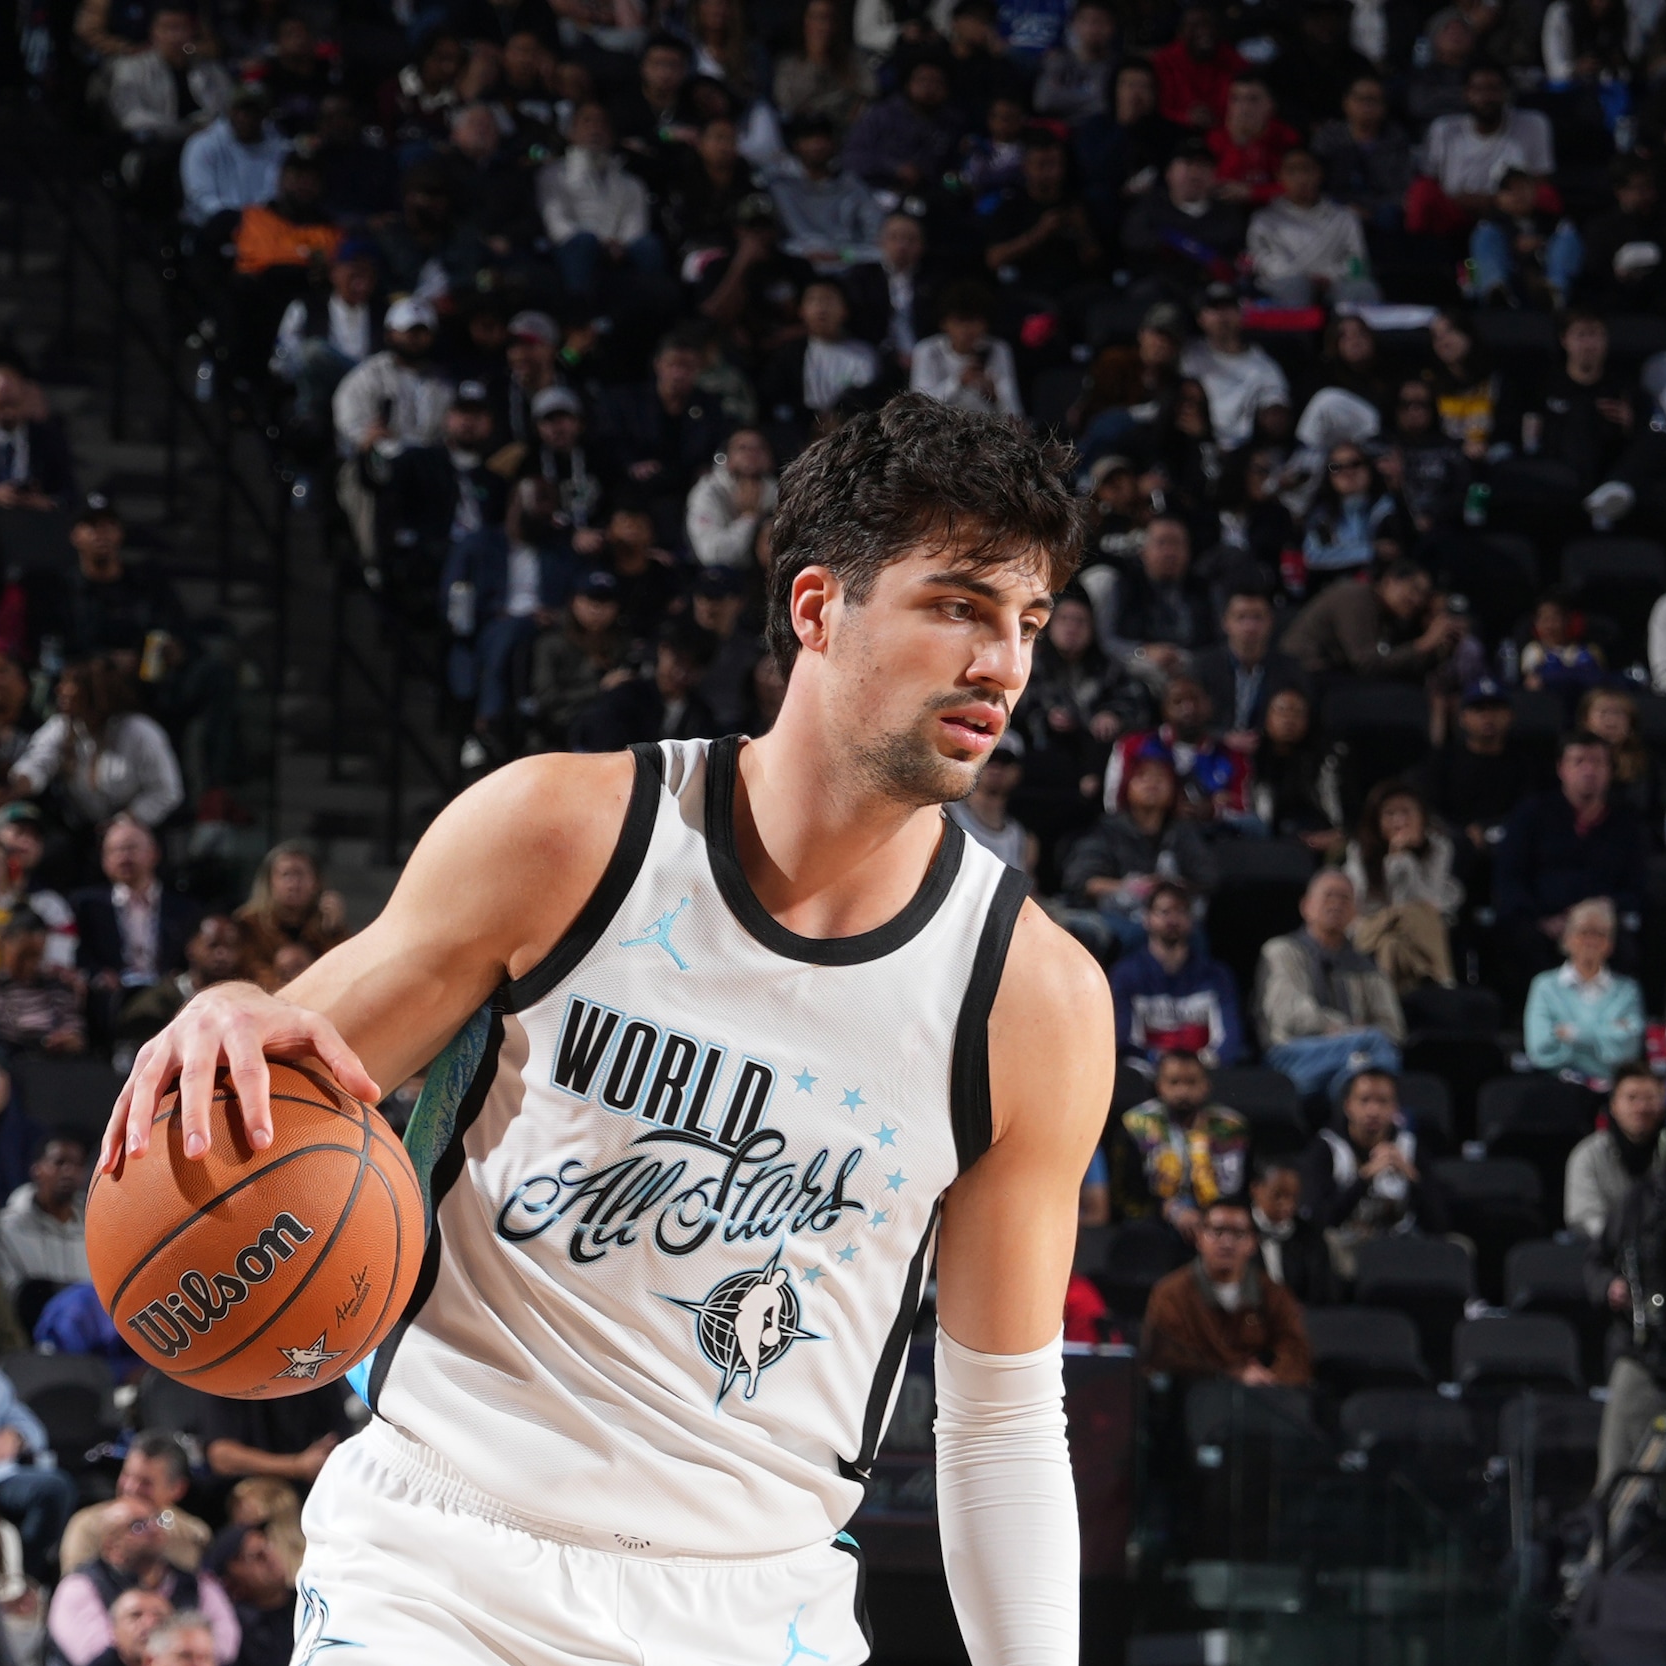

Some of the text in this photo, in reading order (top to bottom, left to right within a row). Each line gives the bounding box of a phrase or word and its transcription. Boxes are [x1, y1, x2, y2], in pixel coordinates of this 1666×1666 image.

[550, 993, 778, 1150] WORLD
[495, 1128, 867, 1264] All Stars
[127, 1211, 314, 1359] Wilson
